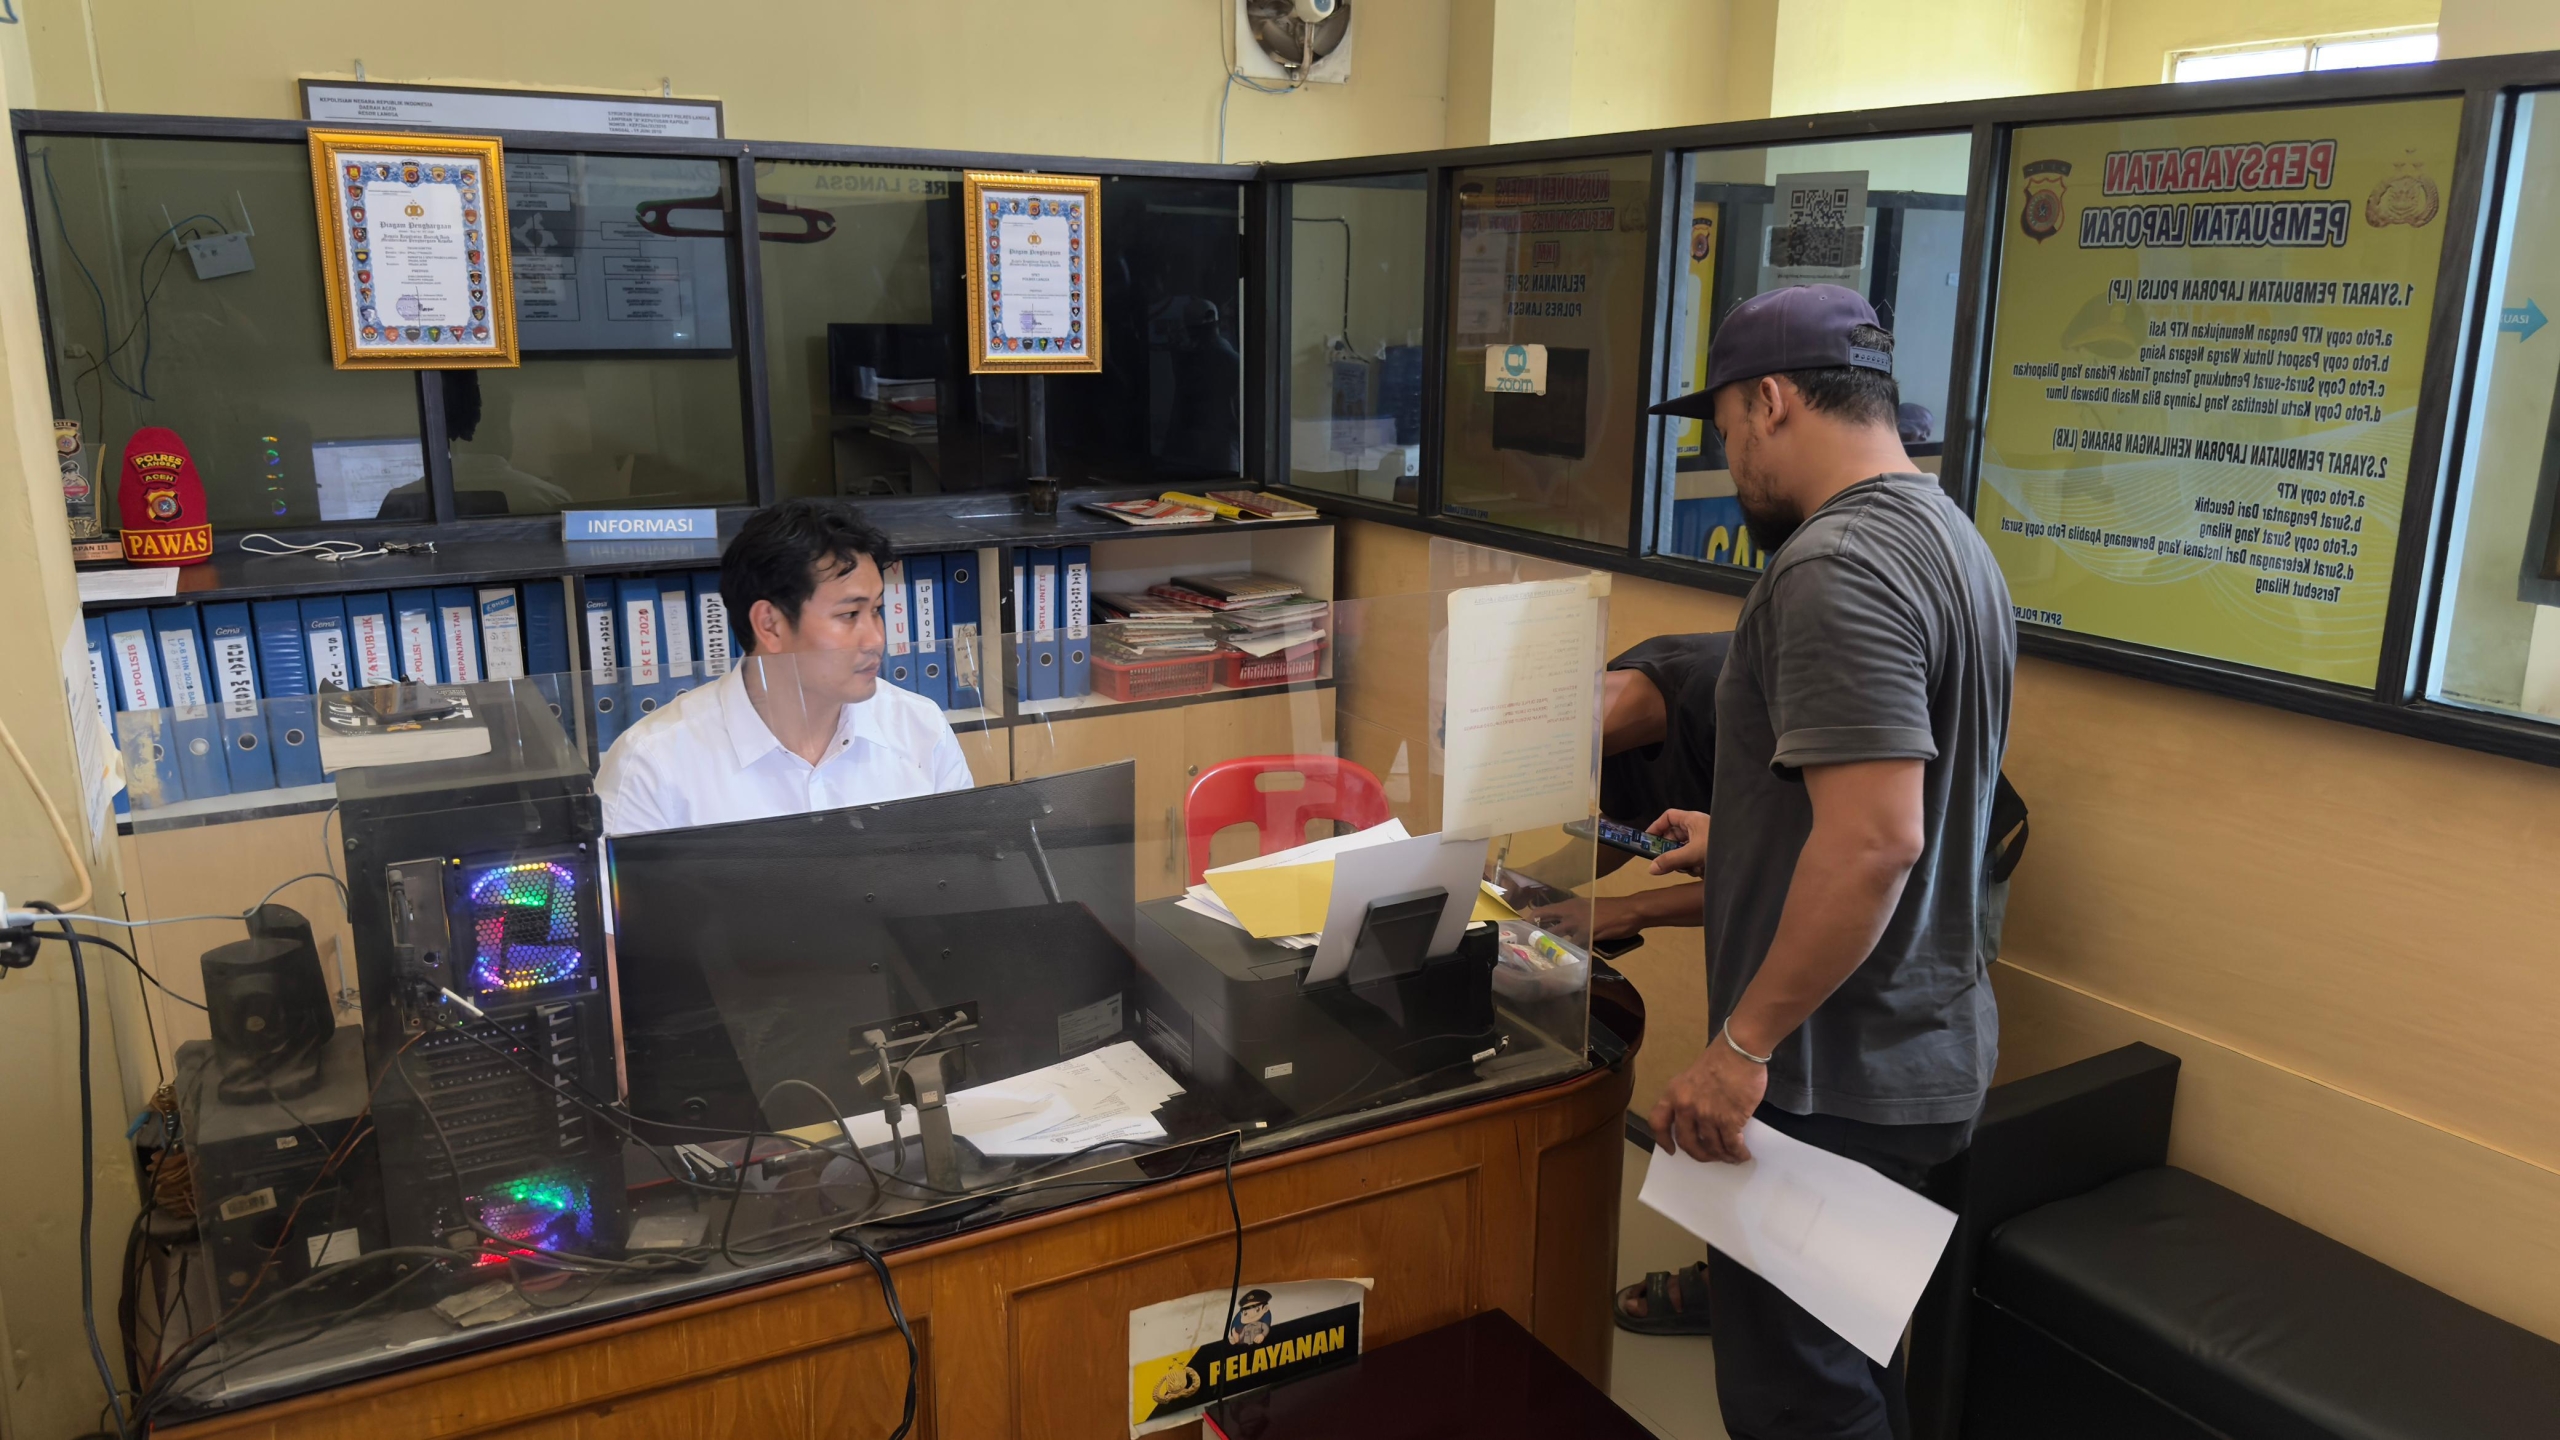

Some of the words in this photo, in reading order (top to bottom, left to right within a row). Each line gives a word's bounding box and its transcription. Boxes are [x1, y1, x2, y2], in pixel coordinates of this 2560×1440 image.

[135, 454, 183, 466] POLRES
[141, 461, 177, 469] LANGSA
[145, 474, 173, 482] ACEH
[588, 518, 693, 533] INFORMASI
[129, 530, 207, 556] PAWAS
[586, 601, 608, 609] Gema
[311, 620, 336, 629] Gema
[452, 612, 461, 627] TAH
[215, 627, 241, 636] Gema
[600, 616, 611, 642] SURAT
[226, 644, 248, 676] SURAT
[413, 644, 423, 672] POLISI
[453, 629, 467, 682] PERPANJANG
[640, 640, 652, 676] SKET
[137, 690, 148, 707] LAP
[230, 679, 254, 713] MASUK
[1209, 1326, 1345, 1386] PELAYANAN
